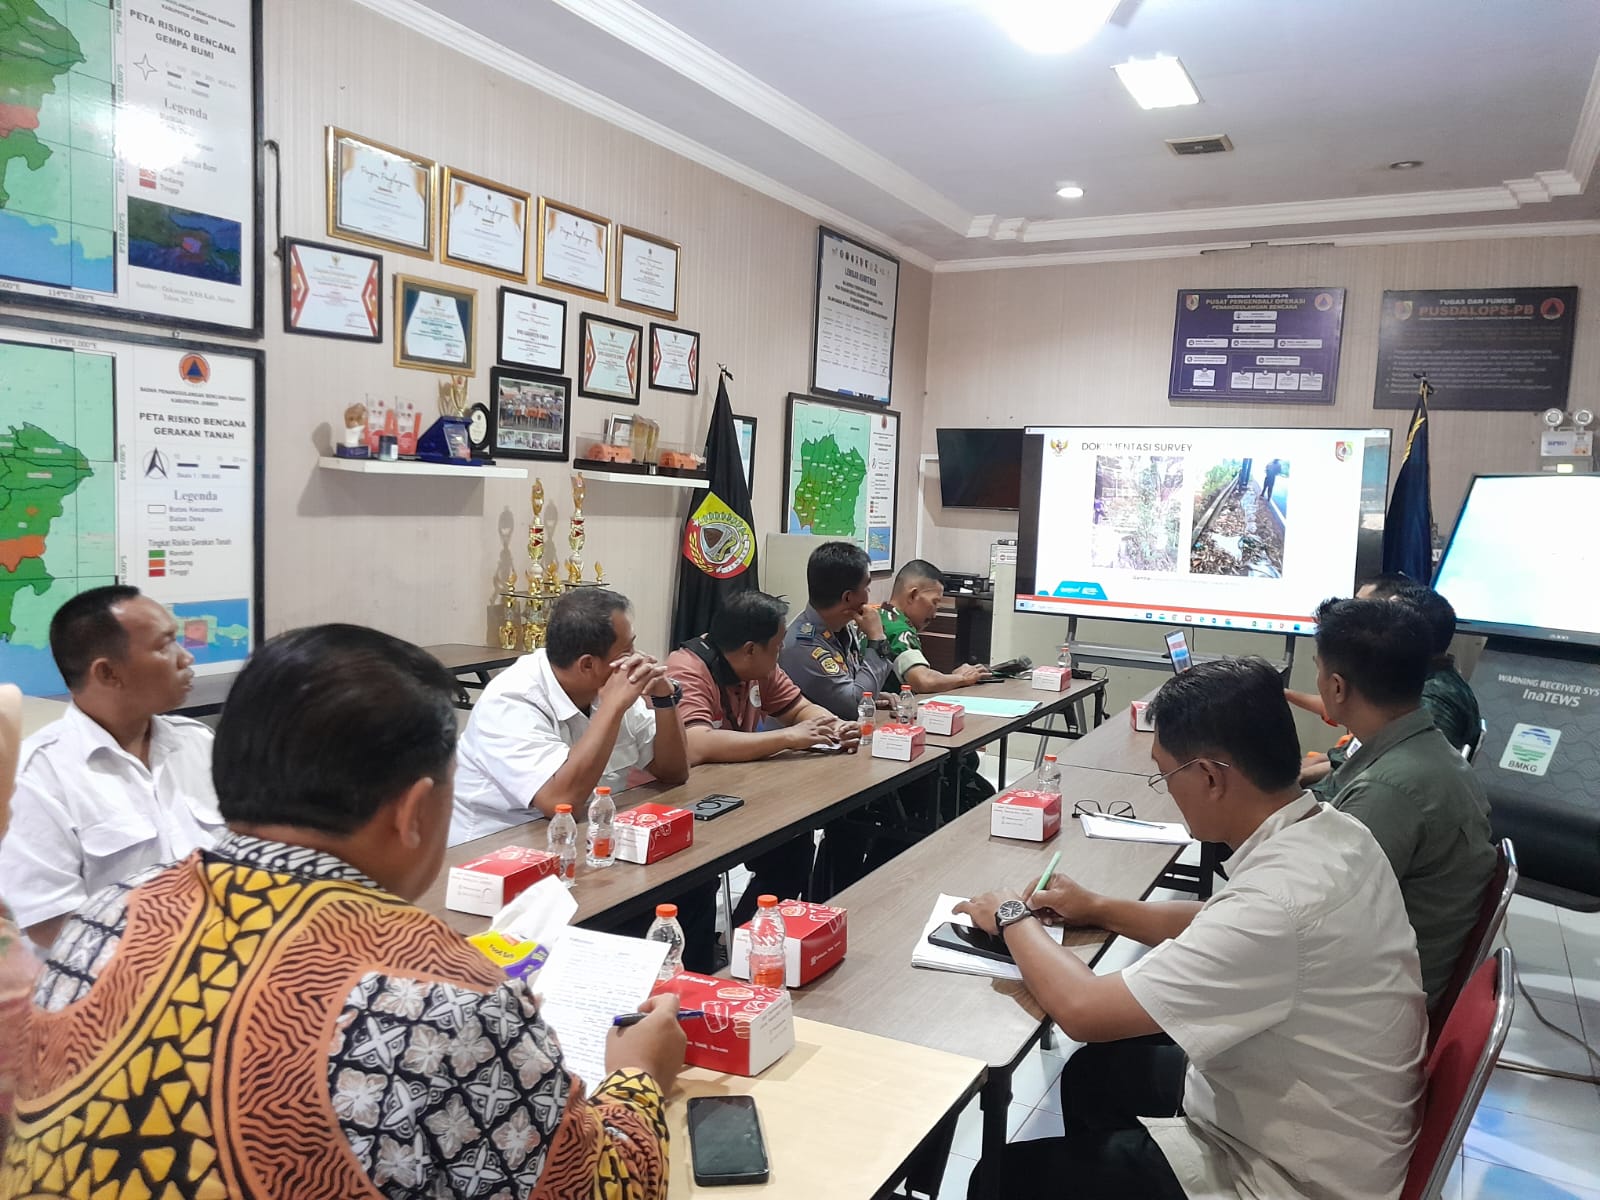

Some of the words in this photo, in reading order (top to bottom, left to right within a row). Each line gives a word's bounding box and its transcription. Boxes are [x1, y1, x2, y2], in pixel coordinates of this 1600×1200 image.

[130, 9, 155, 25] PETA
[158, 20, 190, 38] RISIKO
[193, 33, 236, 54] BENCANA
[156, 32, 188, 50] GEMPA
[191, 45, 214, 59] BUMI
[164, 97, 208, 120] Legenda
[1419, 304, 1534, 316] PUSDALOPS-PB
[139, 413, 165, 422] PETA
[167, 415, 200, 425] RISIKO
[203, 418, 247, 428] BENCANA
[154, 427, 200, 437] GERAKAN
[204, 430, 235, 439] TANAH
[1154, 443, 1192, 452] SURVEY
[174, 490, 218, 503] Legenda
[1498, 674, 1539, 687] WARNING
[1540, 680, 1581, 694] RECEIVER
[1522, 688, 1581, 707] InaTEWS
[1508, 760, 1538, 773] BMKG
